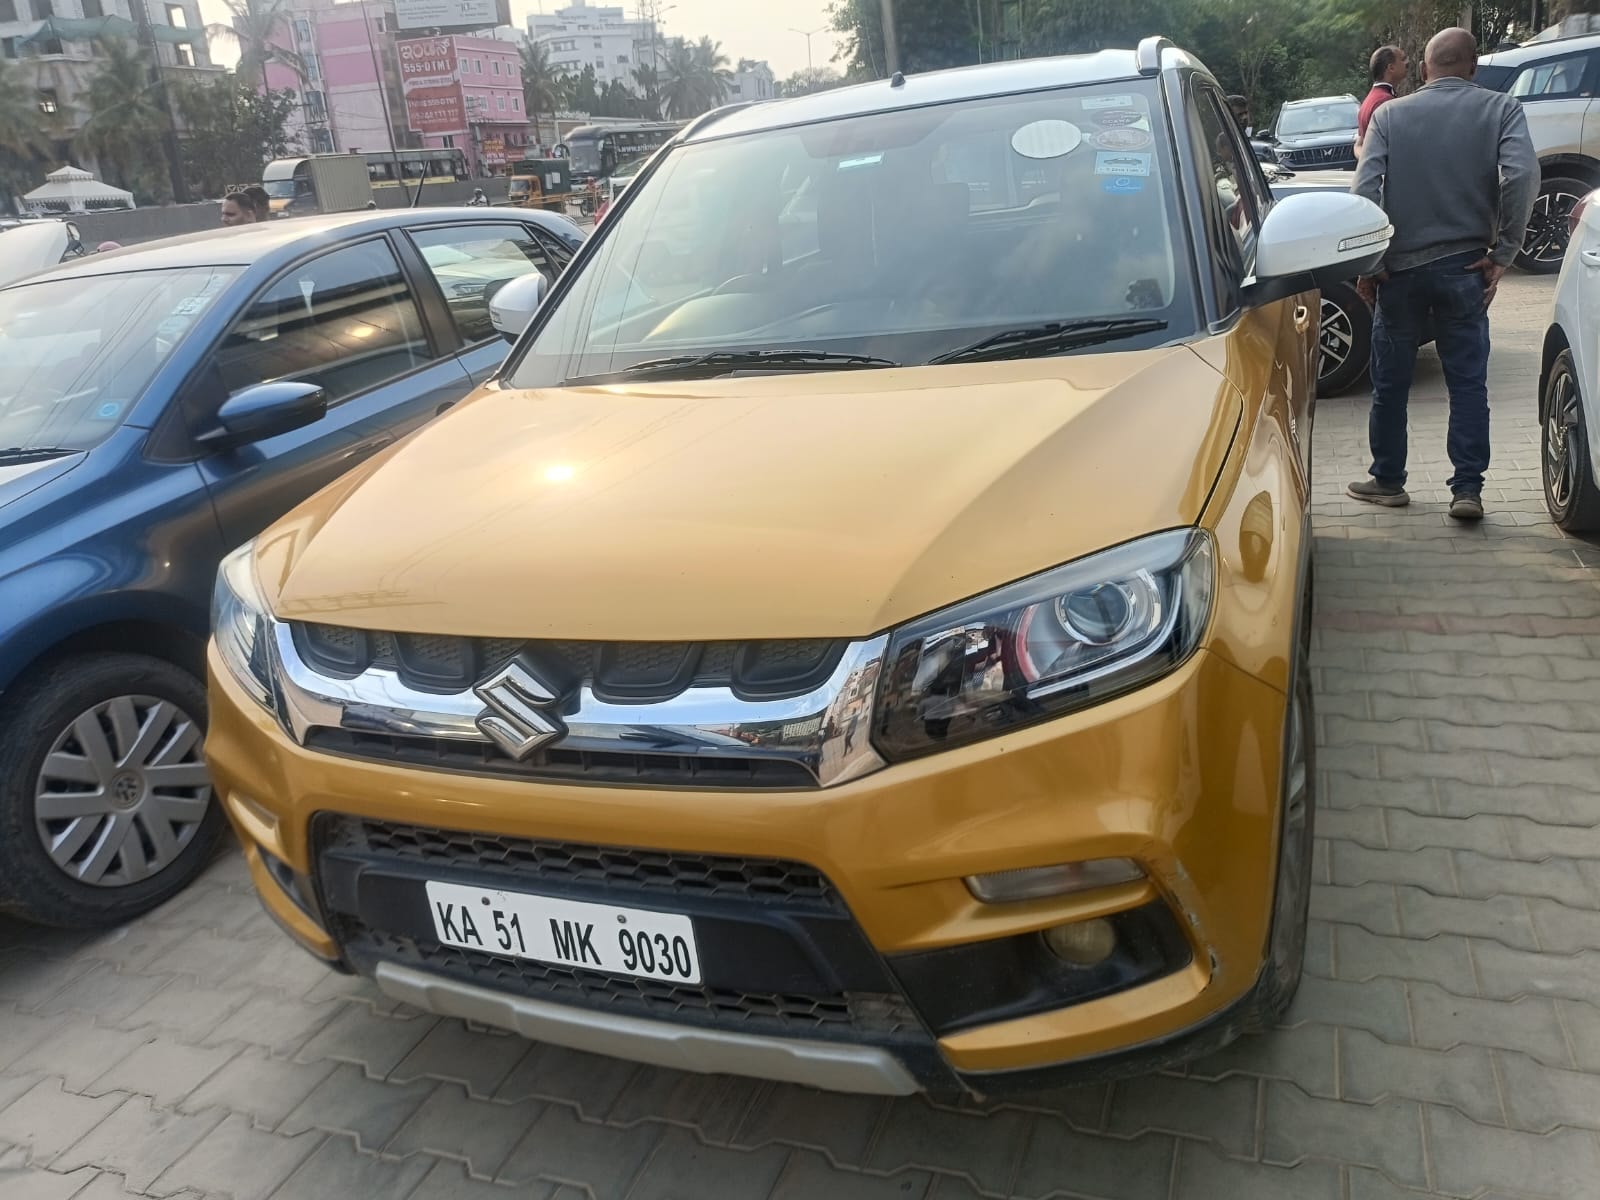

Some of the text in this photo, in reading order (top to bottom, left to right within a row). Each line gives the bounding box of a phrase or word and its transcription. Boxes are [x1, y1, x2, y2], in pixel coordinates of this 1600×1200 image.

[436, 901, 692, 978] KA 51 MK 9030
